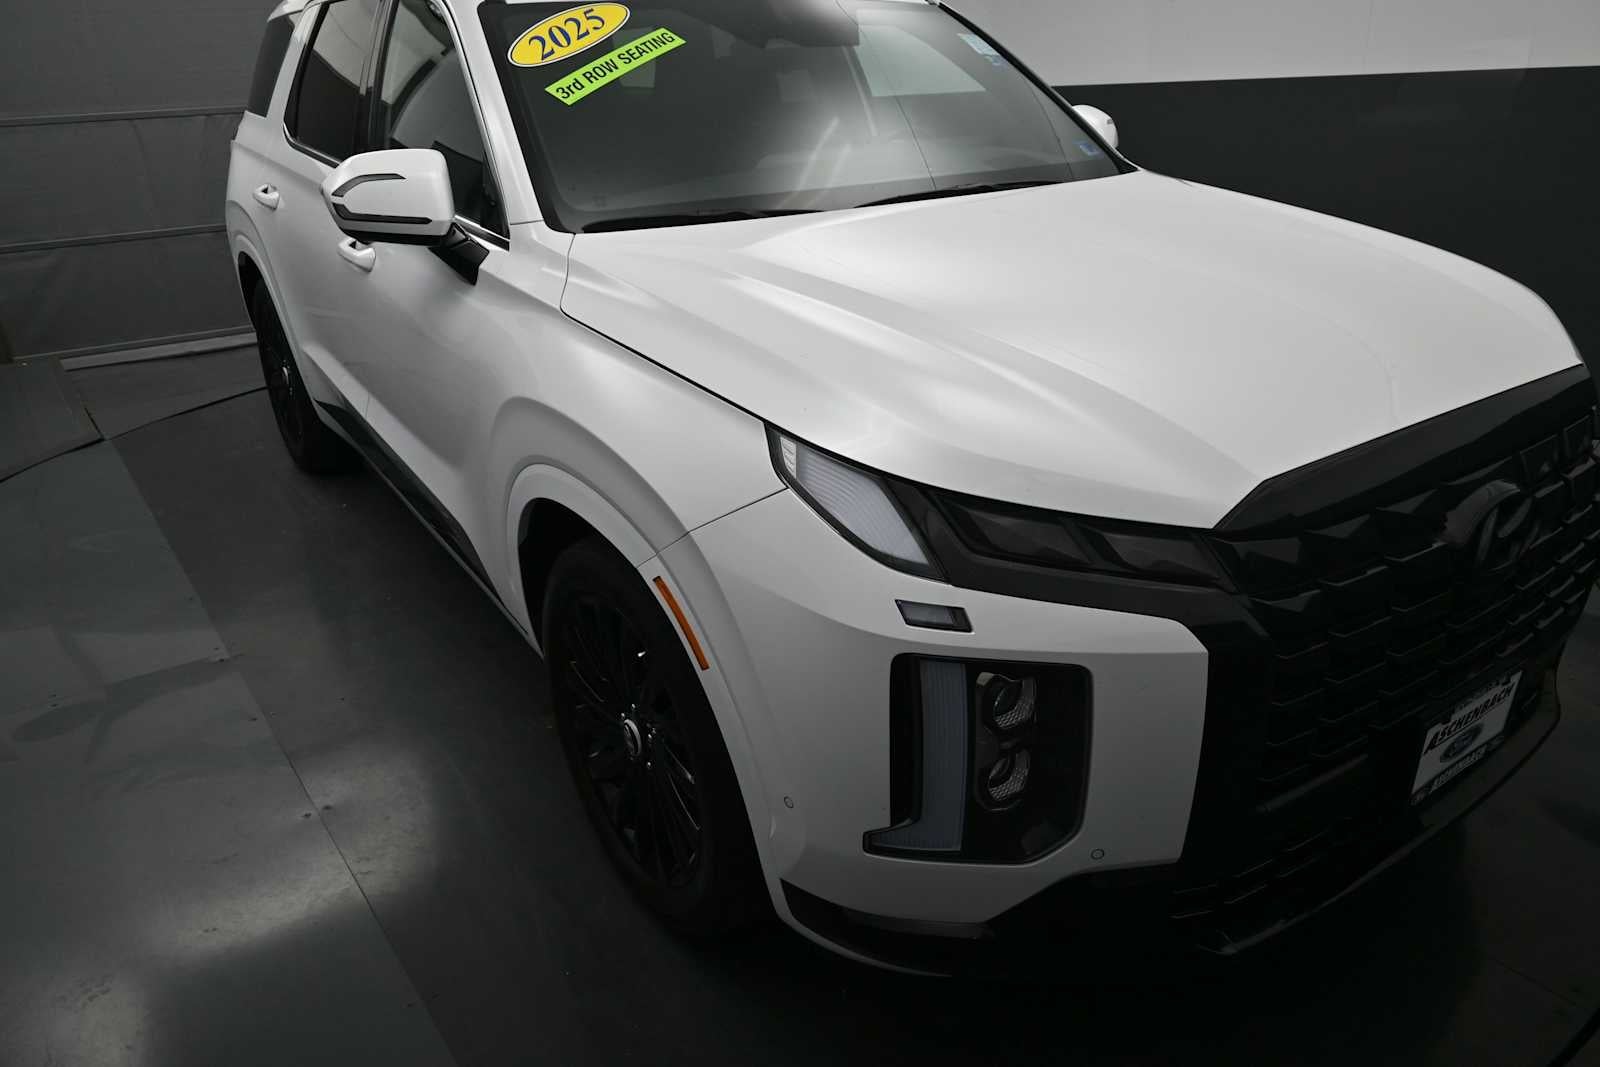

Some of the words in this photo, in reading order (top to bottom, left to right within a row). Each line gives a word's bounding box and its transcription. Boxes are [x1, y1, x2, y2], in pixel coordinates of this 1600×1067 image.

[528, 8, 605, 61] 2025
[556, 78, 585, 100] 3rd
[582, 58, 619, 84] ROW
[617, 32, 676, 65] SEATING
[1424, 682, 1516, 754] ASCHENBACH
